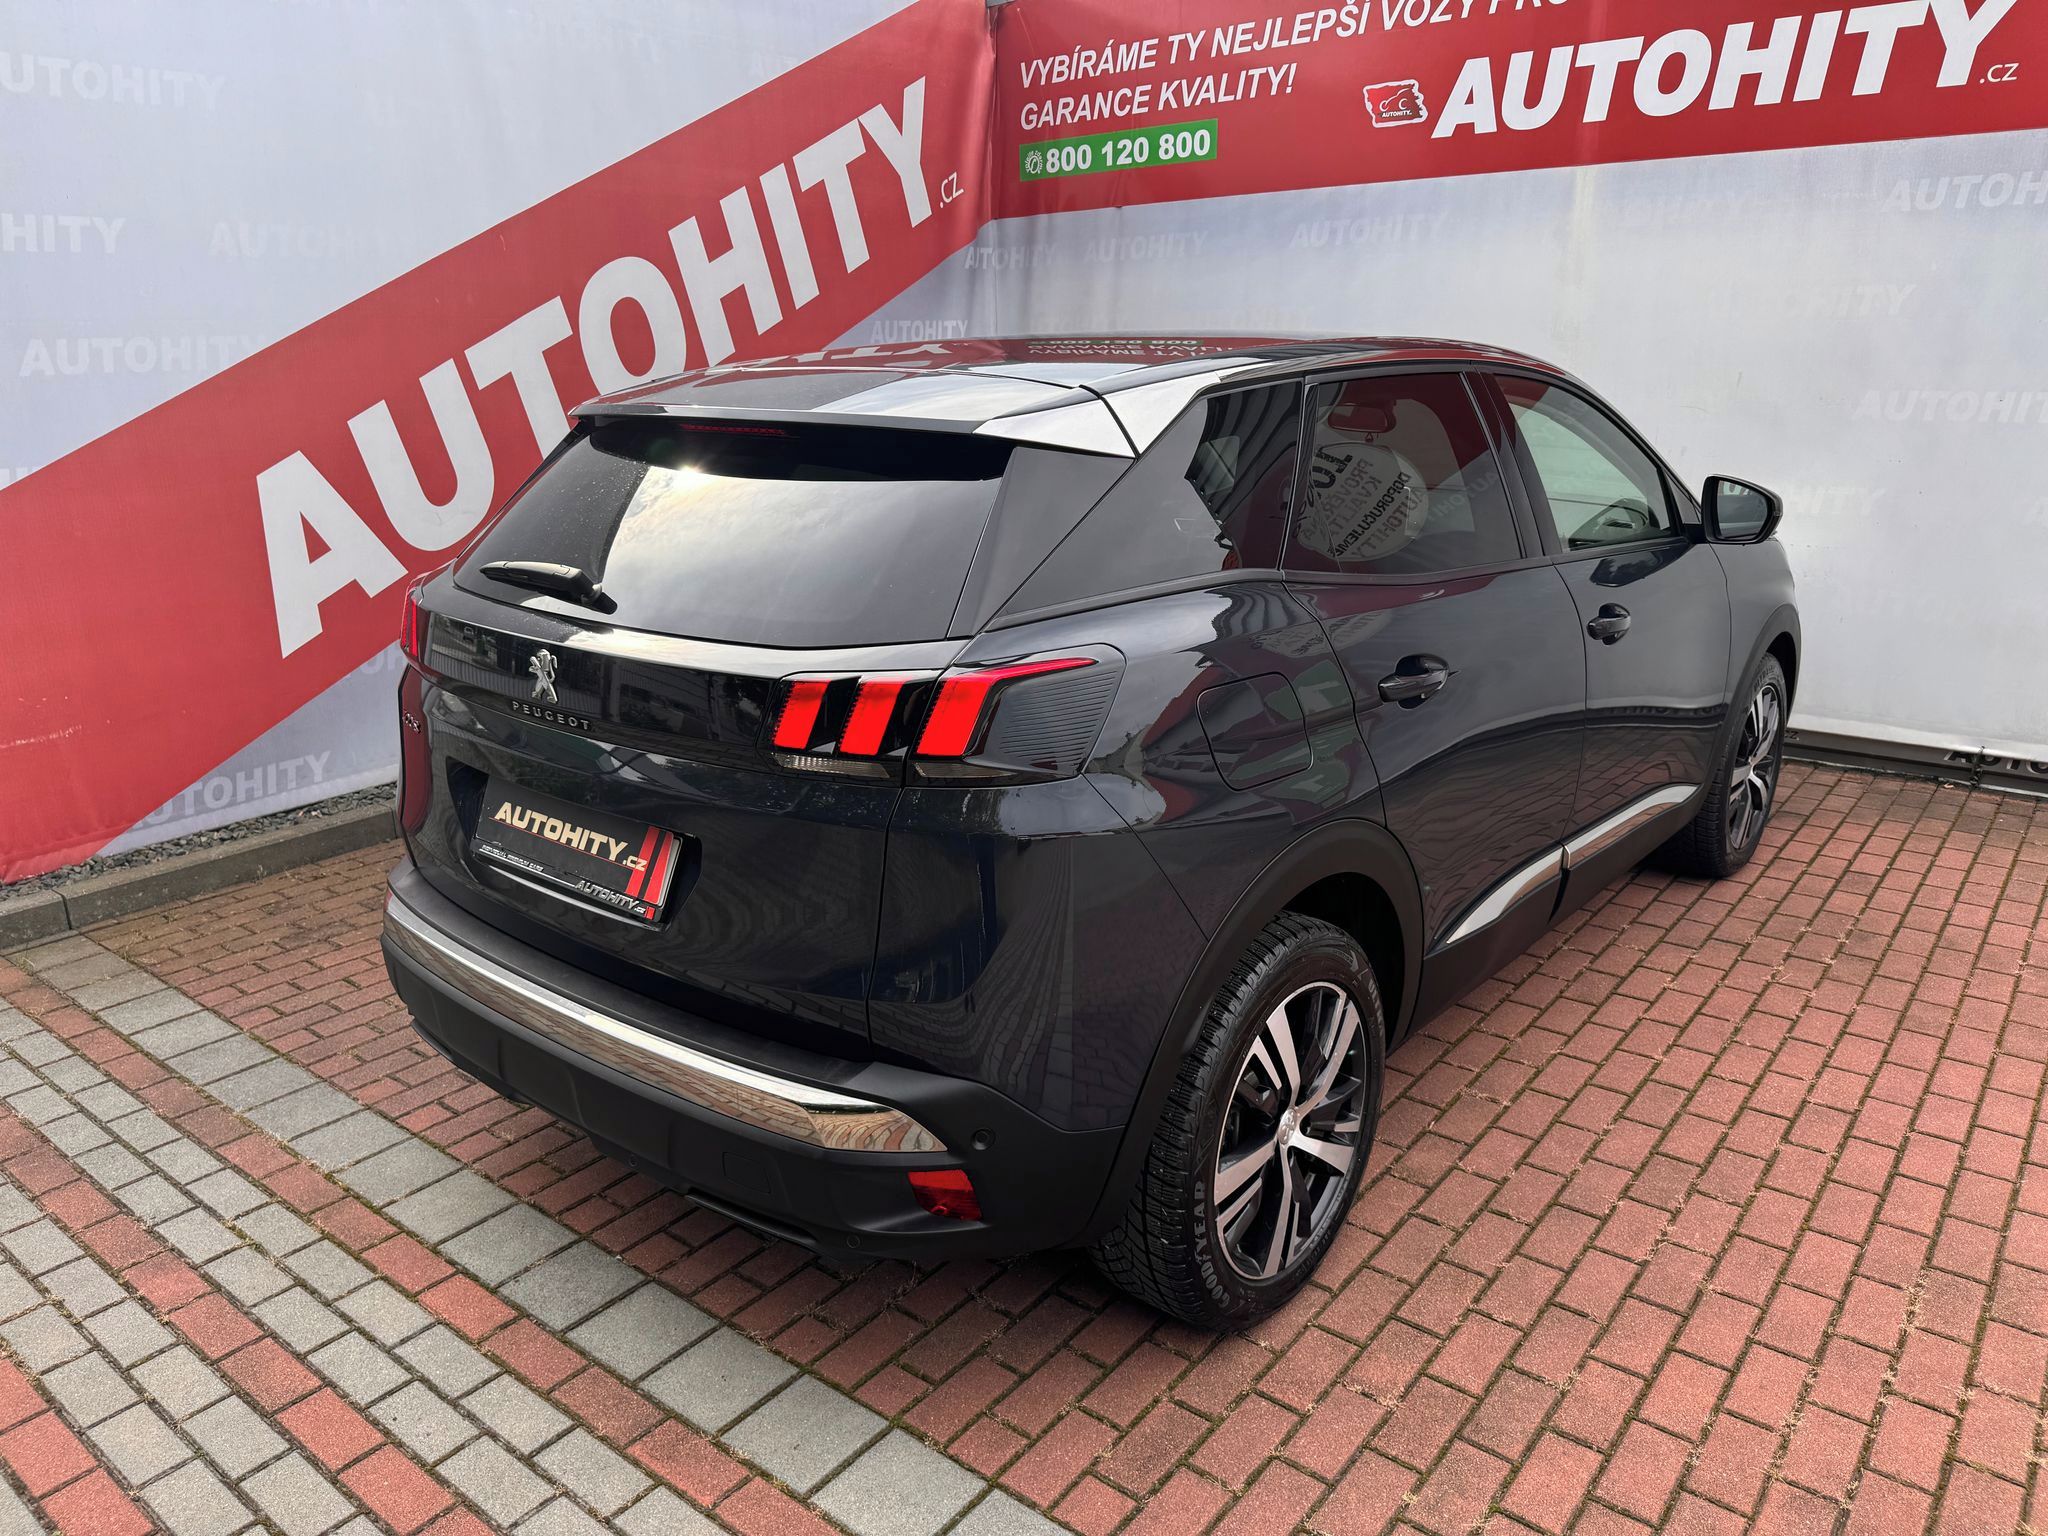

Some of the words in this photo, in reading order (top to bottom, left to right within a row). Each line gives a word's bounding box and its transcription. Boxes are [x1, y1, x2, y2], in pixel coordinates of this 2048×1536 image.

[1020, 38, 1159, 89] VYBÍRÁME
[1167, 30, 1206, 64] TY
[1020, 84, 1152, 130] GARANCE
[1158, 62, 1298, 111] KVALITY!
[1046, 144, 1092, 173] 800
[1101, 137, 1149, 167] 120
[1159, 129, 1211, 160] 800
[511, 701, 591, 731] PEUGEOT
